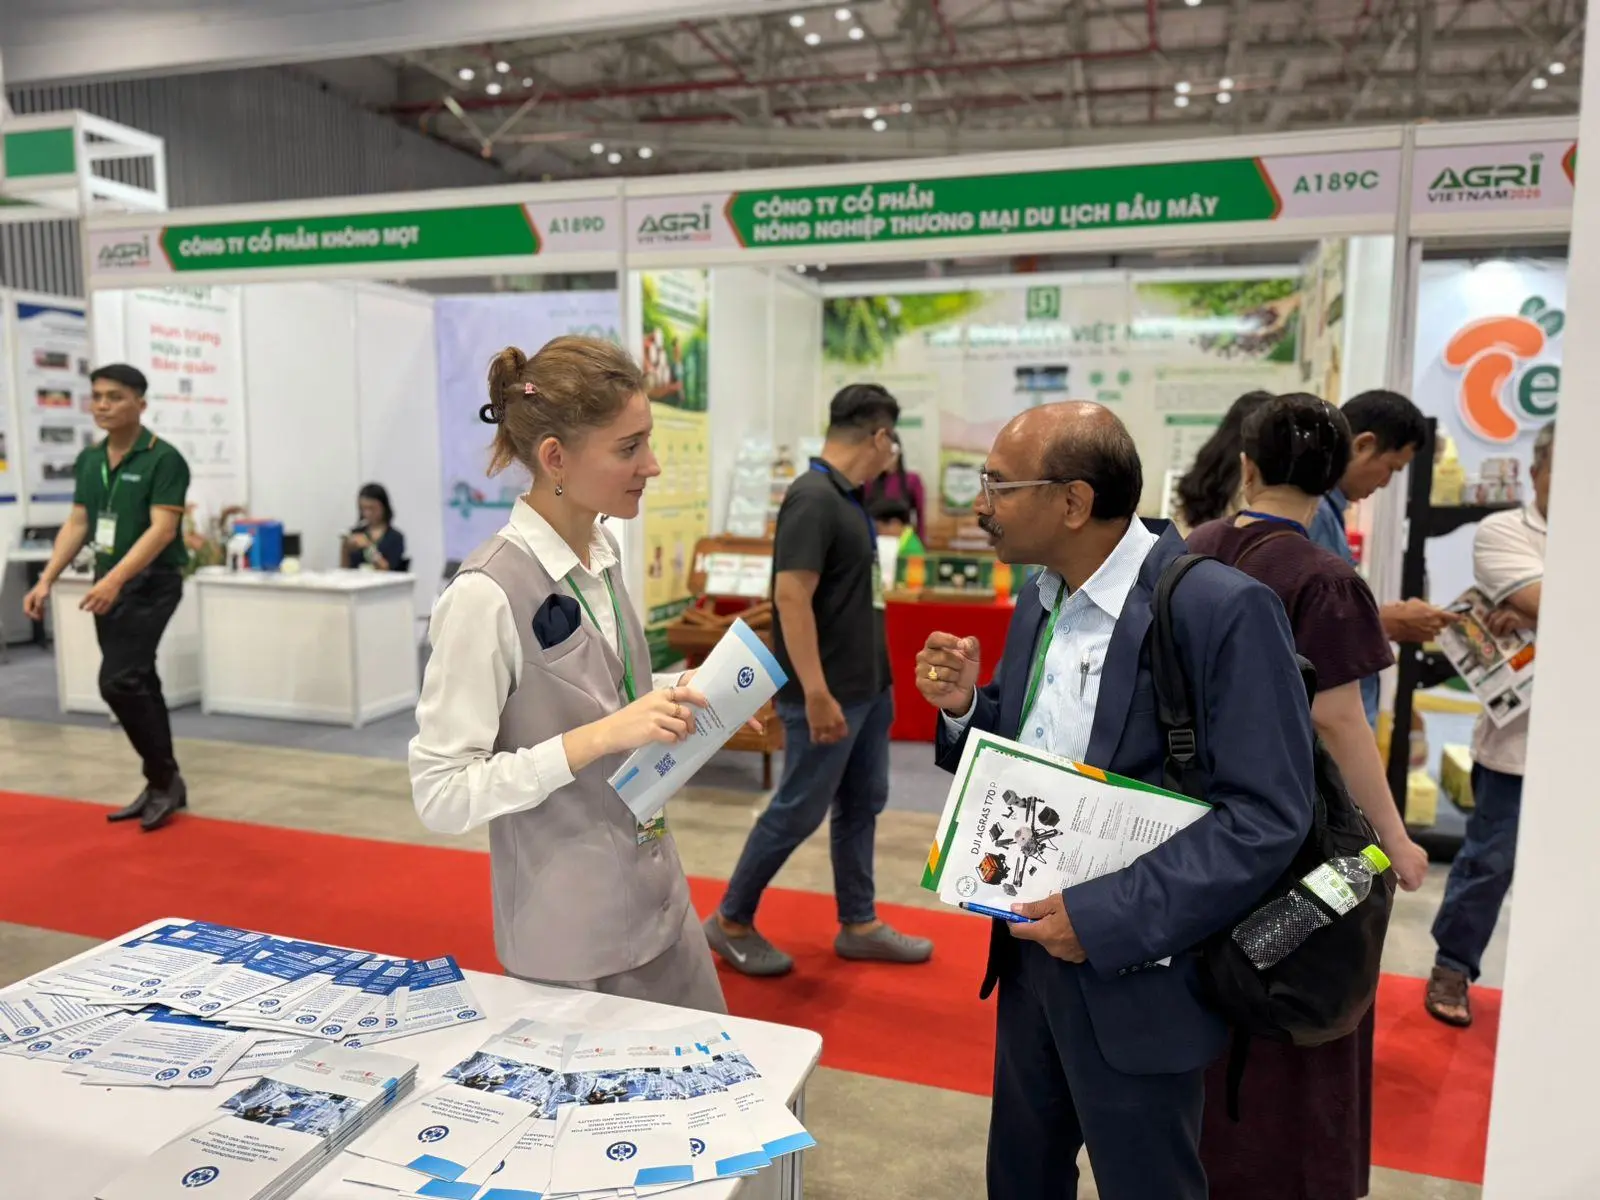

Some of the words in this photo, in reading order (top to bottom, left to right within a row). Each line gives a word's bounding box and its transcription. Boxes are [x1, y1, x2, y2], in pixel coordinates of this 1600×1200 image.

[1293, 170, 1380, 194] A189C
[1428, 153, 1544, 189] AGRI
[637, 203, 713, 233] AGRI
[753, 195, 812, 218] CÔNG
[816, 196, 839, 214] TY
[753, 219, 811, 242] NÔNG
[815, 214, 886, 241] NGHIỆP
[890, 211, 975, 235] THƯƠNG
[979, 208, 1019, 233] MẠI
[1024, 206, 1055, 226] DU
[1060, 203, 1110, 229] LỊCH
[1166, 193, 1219, 218] MÂY
[549, 215, 605, 234] A189D
[179, 232, 227, 257] CÔNG
[227, 236, 246, 254] TY
[320, 226, 380, 248] KHÔNG
[971, 840, 981, 855] DJI
[976, 808, 991, 838] AGRAS
[984, 790, 996, 805] T70
